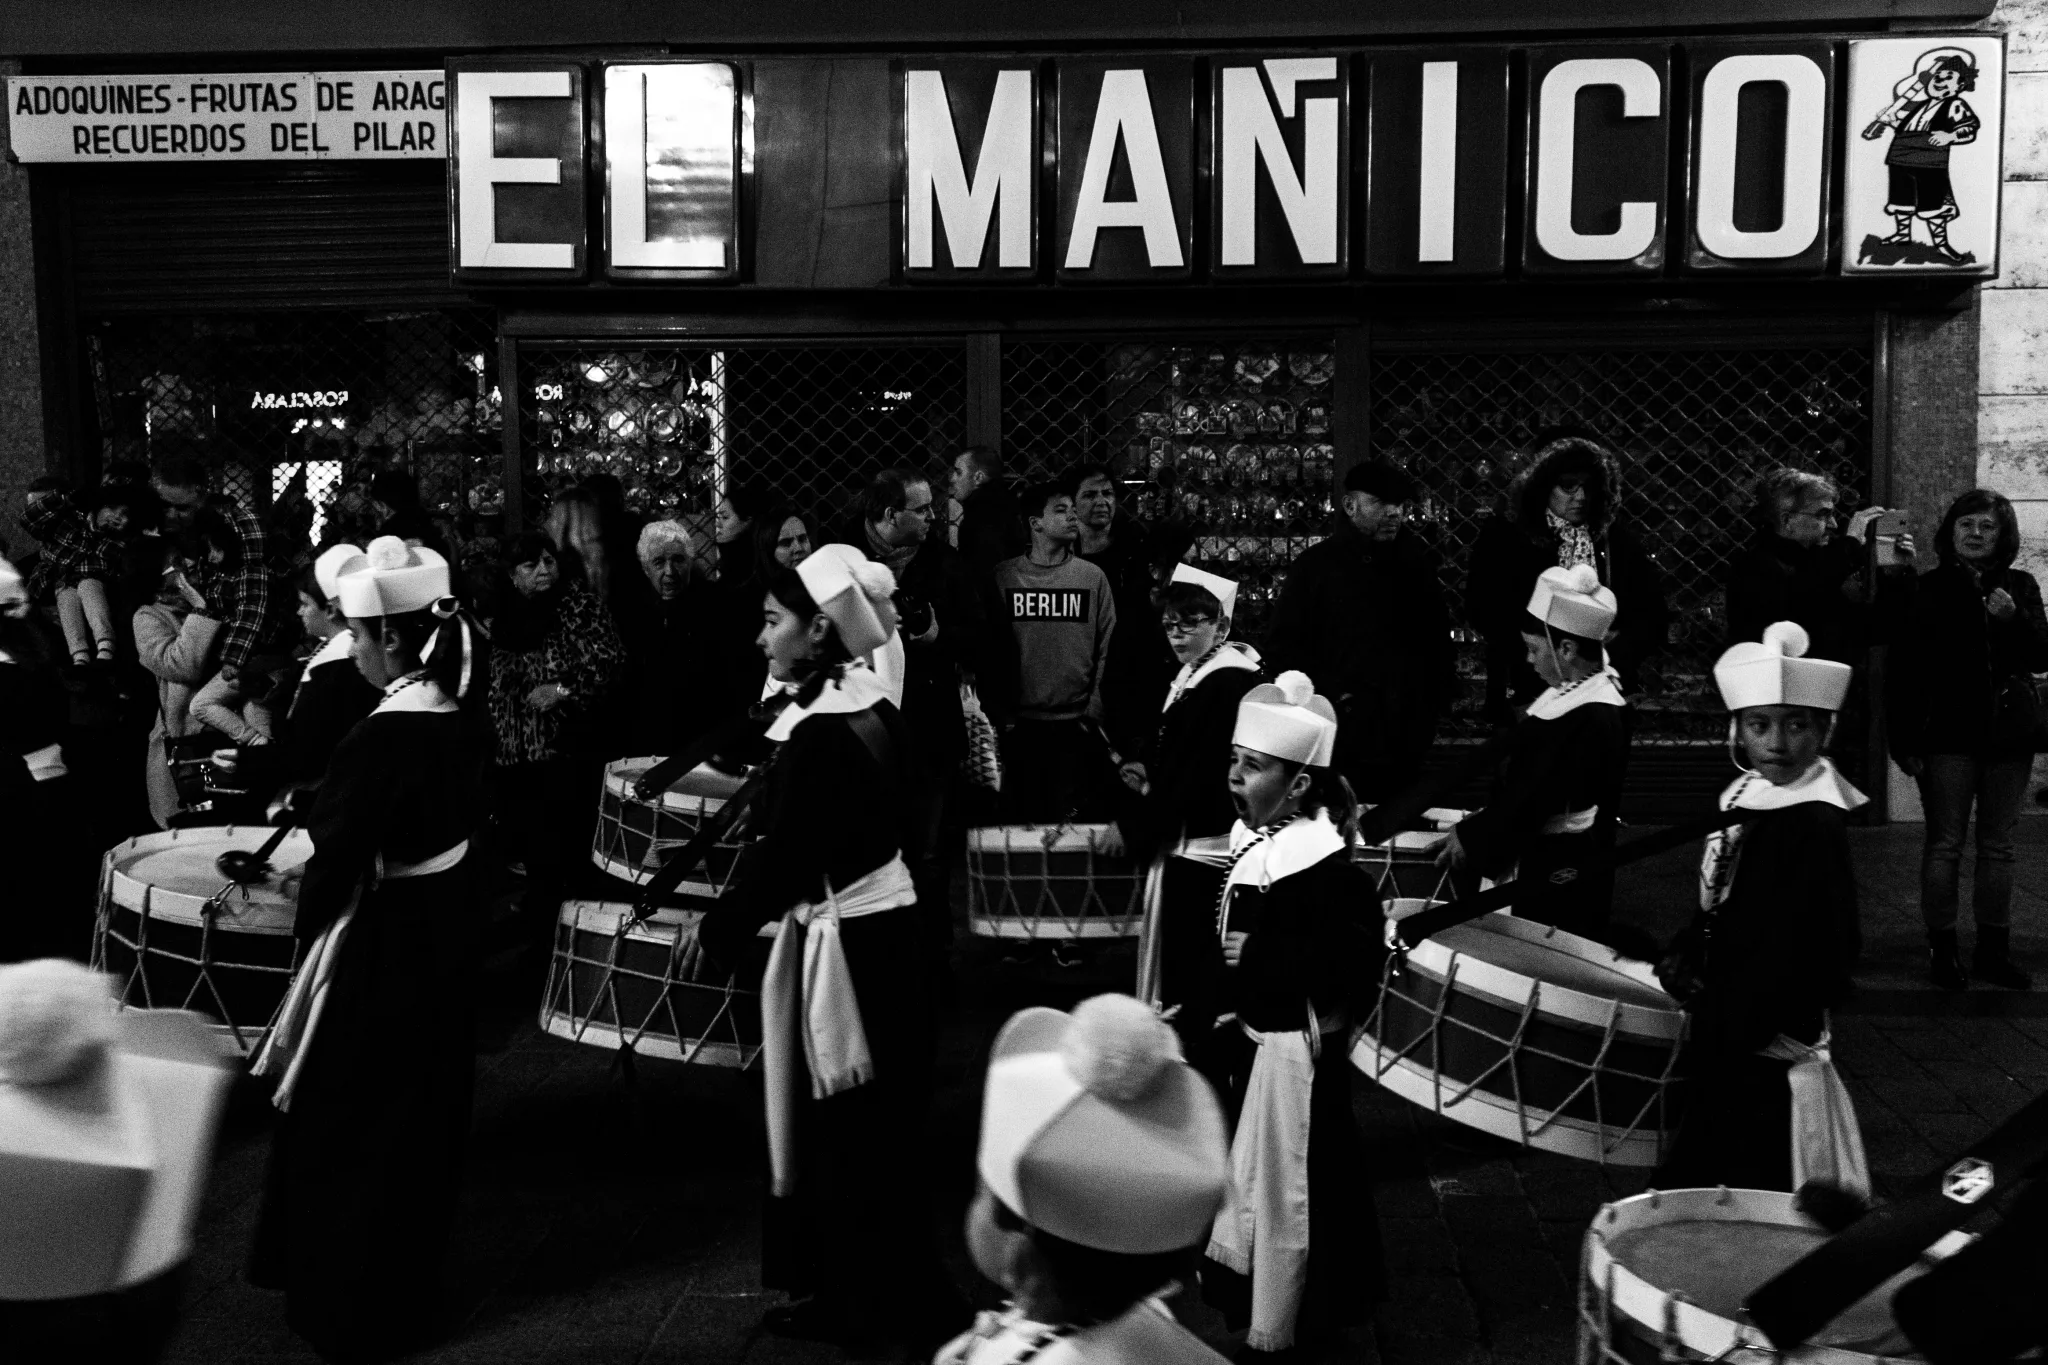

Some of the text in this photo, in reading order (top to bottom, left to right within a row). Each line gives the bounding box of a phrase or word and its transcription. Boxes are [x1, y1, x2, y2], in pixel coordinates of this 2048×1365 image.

[317, 82, 355, 112] DE
[73, 122, 437, 155] RECUERDOS DEL PILAR
[457, 55, 1827, 269] EL MAÑICO
[1013, 592, 1082, 618] BERLIN
